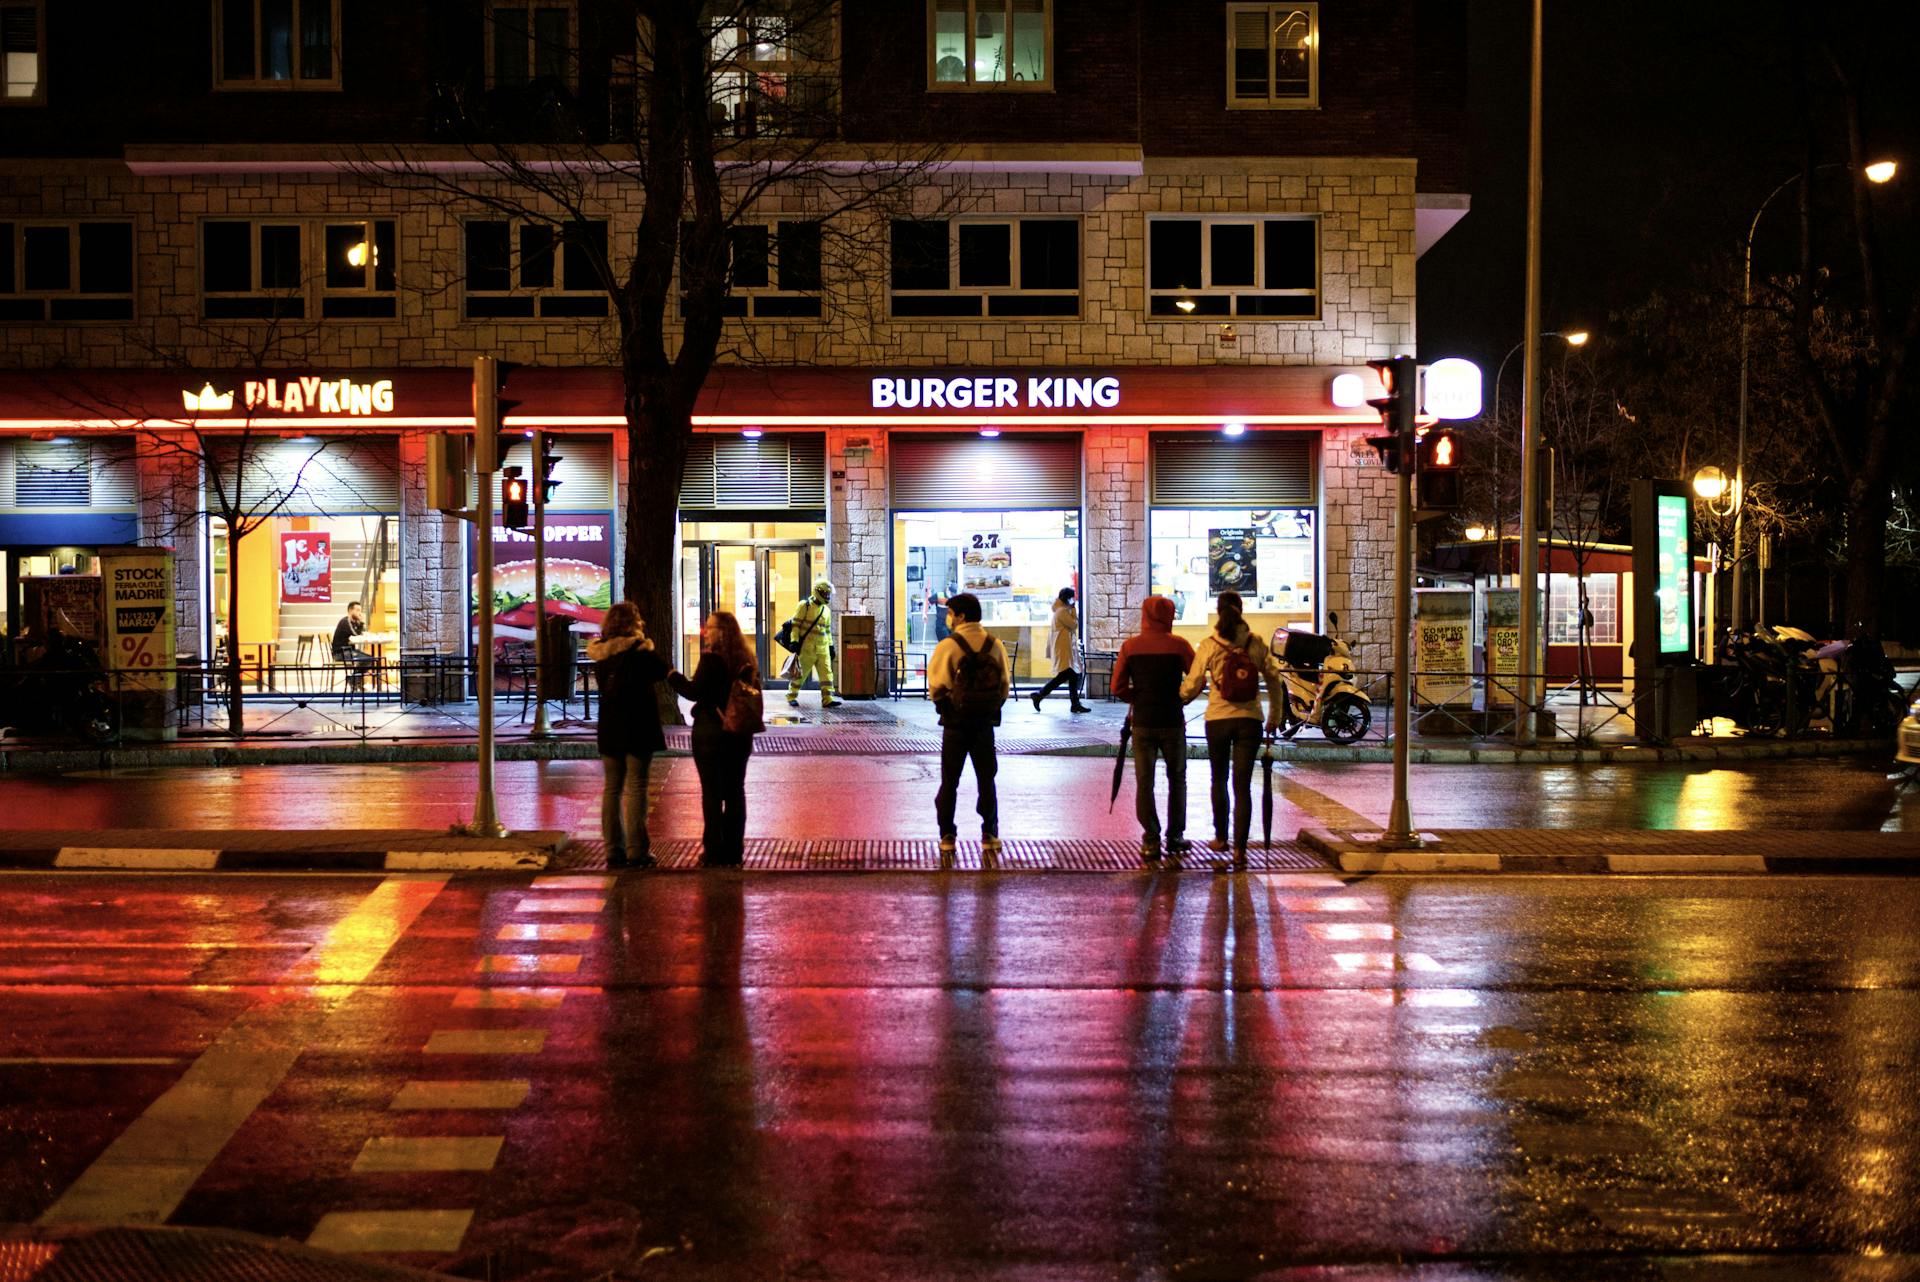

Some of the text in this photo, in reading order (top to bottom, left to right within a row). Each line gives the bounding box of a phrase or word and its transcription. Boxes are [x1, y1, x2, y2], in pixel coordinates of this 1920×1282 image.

[245, 377, 394, 415] PLAYKING
[872, 377, 1120, 408] BURGER KING
[284, 538, 308, 564] 1€
[115, 568, 165, 580] STOCK
[139, 581, 165, 589] OUTLE
[119, 619, 157, 627] MARZO
[1423, 626, 1464, 635] COMPRO
[121, 636, 153, 667] %
